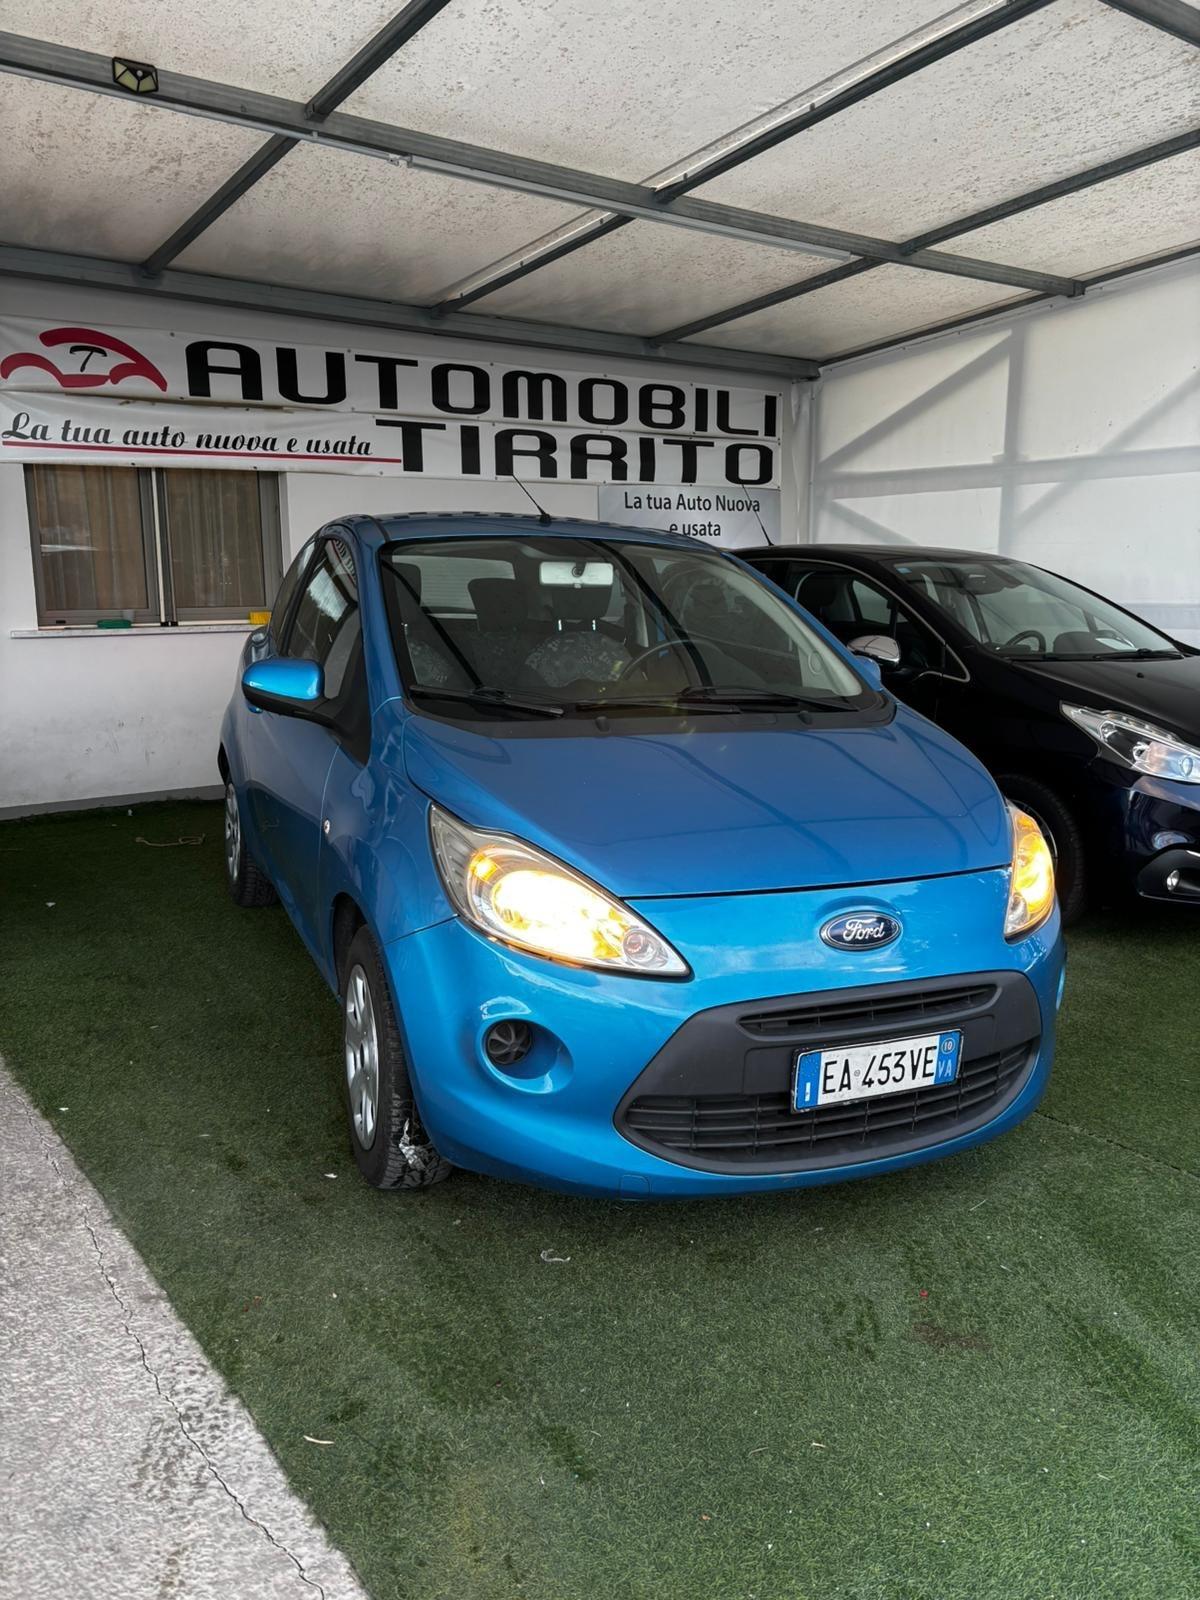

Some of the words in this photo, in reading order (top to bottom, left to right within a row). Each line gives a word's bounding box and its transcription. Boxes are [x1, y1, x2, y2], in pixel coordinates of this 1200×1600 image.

[185, 340, 777, 437] AUTOMOBILI
[2, 412, 52, 441] La
[61, 419, 113, 445] tua
[122, 425, 188, 448] auto
[195, 432, 282, 453] nuova
[286, 437, 300, 453] e
[305, 435, 374, 456] usata
[375, 418, 773, 486] TIRRITO
[624, 491, 642, 510] La
[647, 494, 671, 510] tua
[676, 494, 711, 511] Auto
[716, 495, 760, 513] Nuova
[669, 523, 678, 533] e
[682, 521, 721, 537] usata
[843, 918, 885, 940] Ford
[823, 1059, 851, 1094] EA
[862, 1046, 937, 1088] 453VE
[938, 1059, 952, 1078] VA
